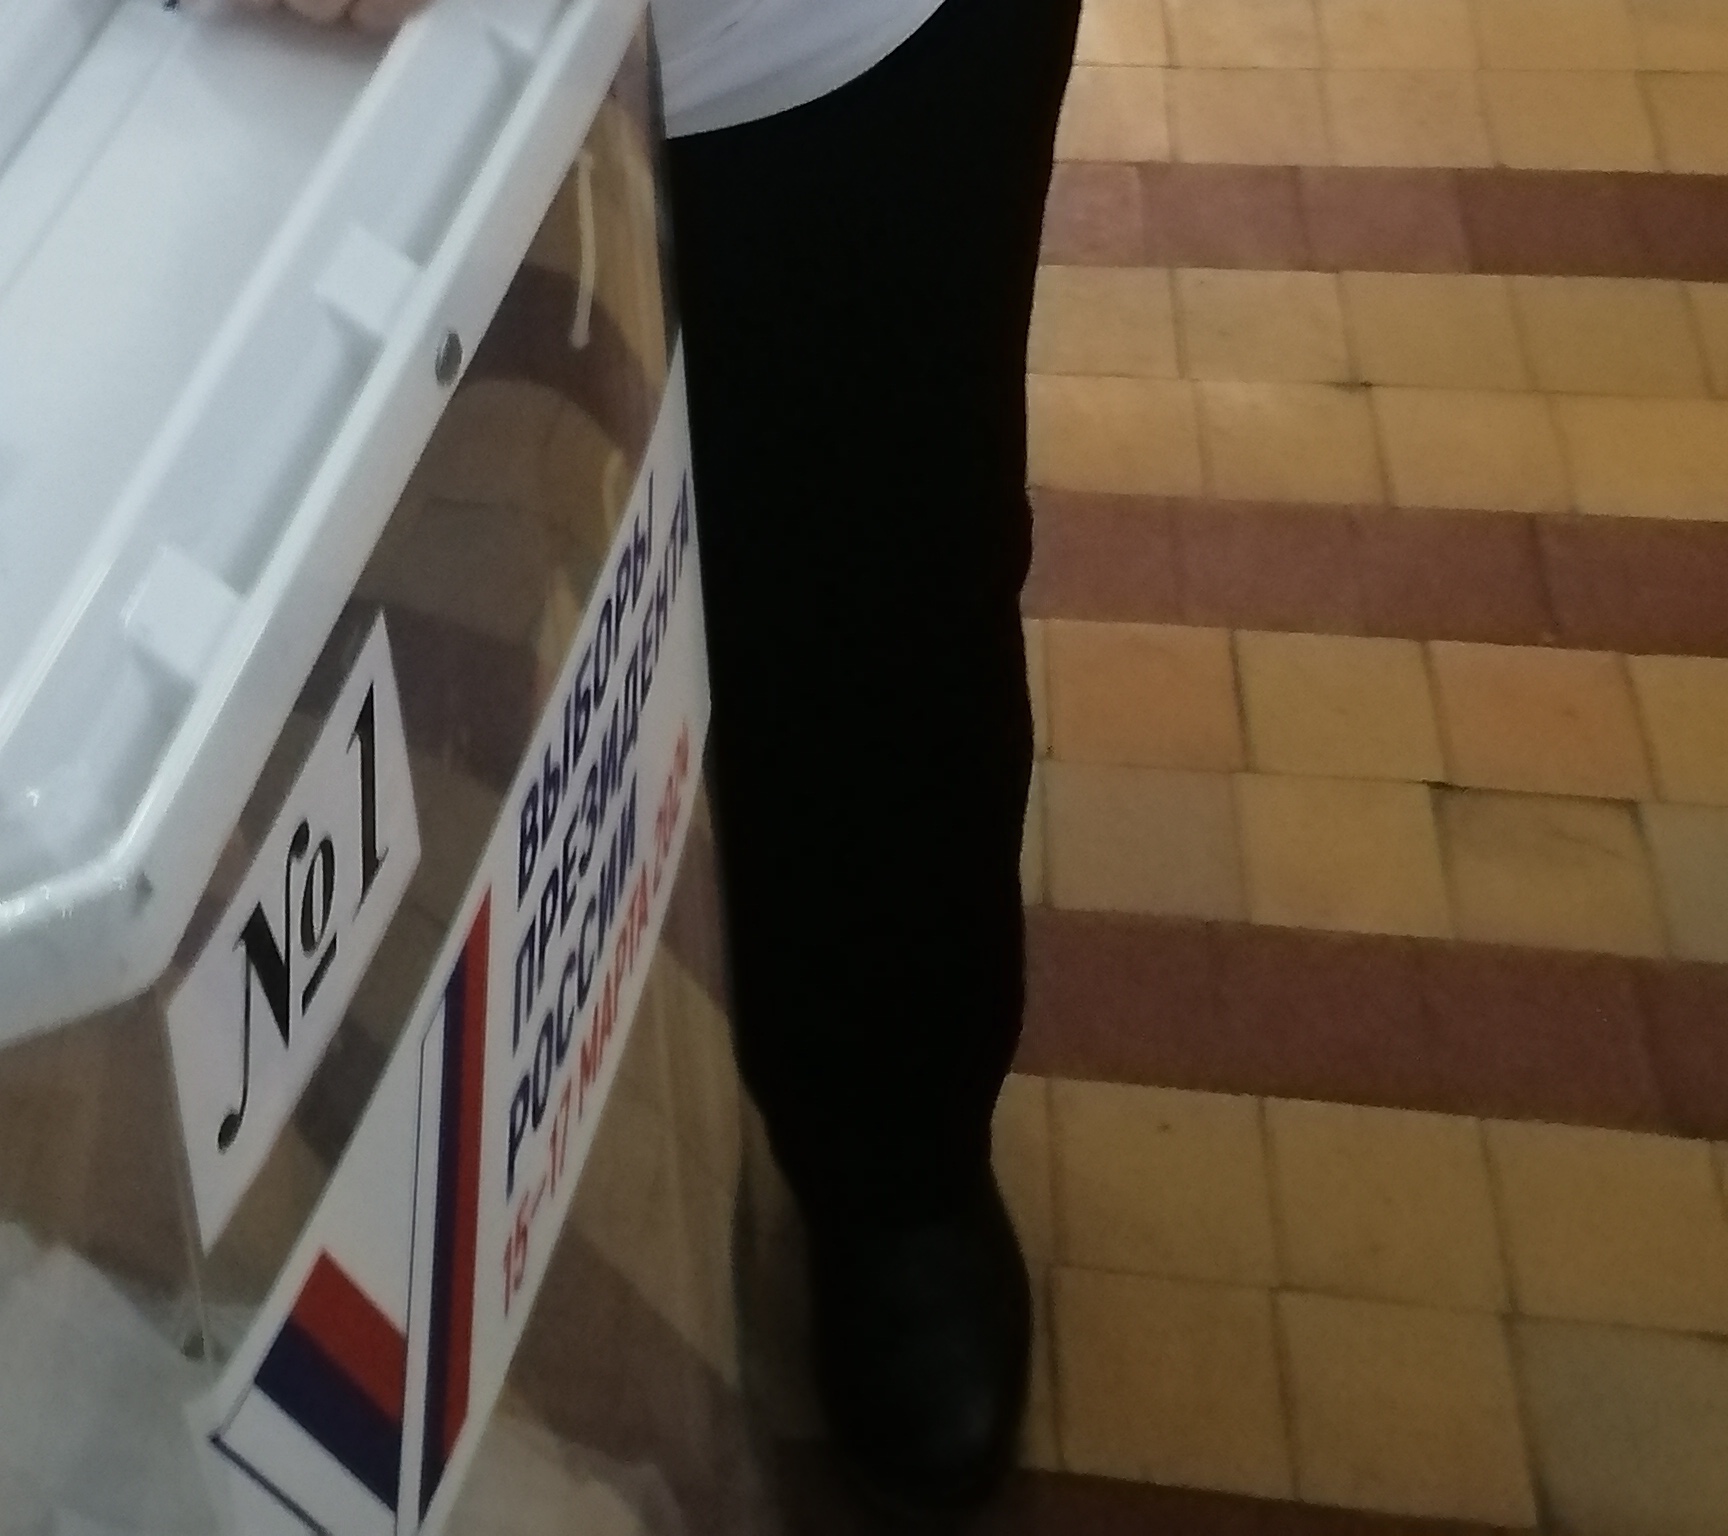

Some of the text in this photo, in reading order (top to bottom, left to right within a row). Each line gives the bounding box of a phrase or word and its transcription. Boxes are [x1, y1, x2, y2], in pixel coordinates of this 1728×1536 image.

[510, 466, 691, 1060] ПРЕЗИДЕНТА
[516, 468, 656, 914] ВЫБОРЫ
[504, 770, 639, 1205] РОССИИ
[577, 858, 650, 1122] МАРТА
